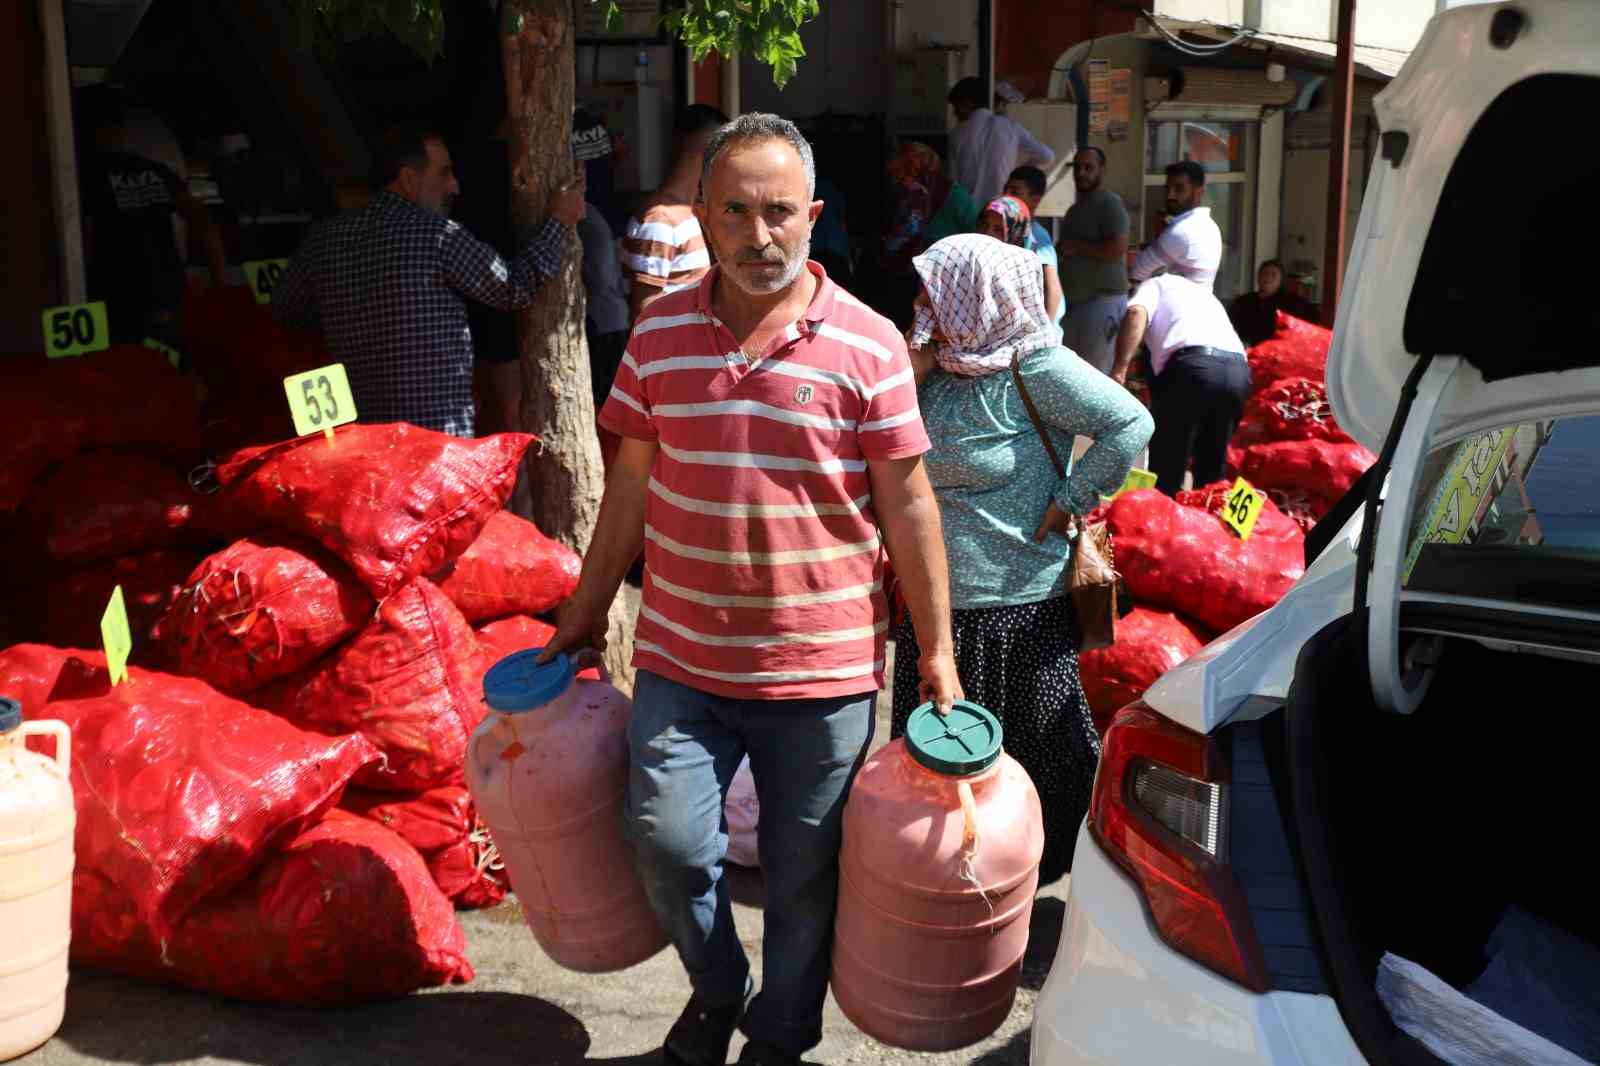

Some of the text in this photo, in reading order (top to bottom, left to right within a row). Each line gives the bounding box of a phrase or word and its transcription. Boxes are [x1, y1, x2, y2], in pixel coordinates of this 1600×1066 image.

[53, 308, 94, 349] 50
[301, 376, 338, 425] 53
[1229, 488, 1253, 524] 46
